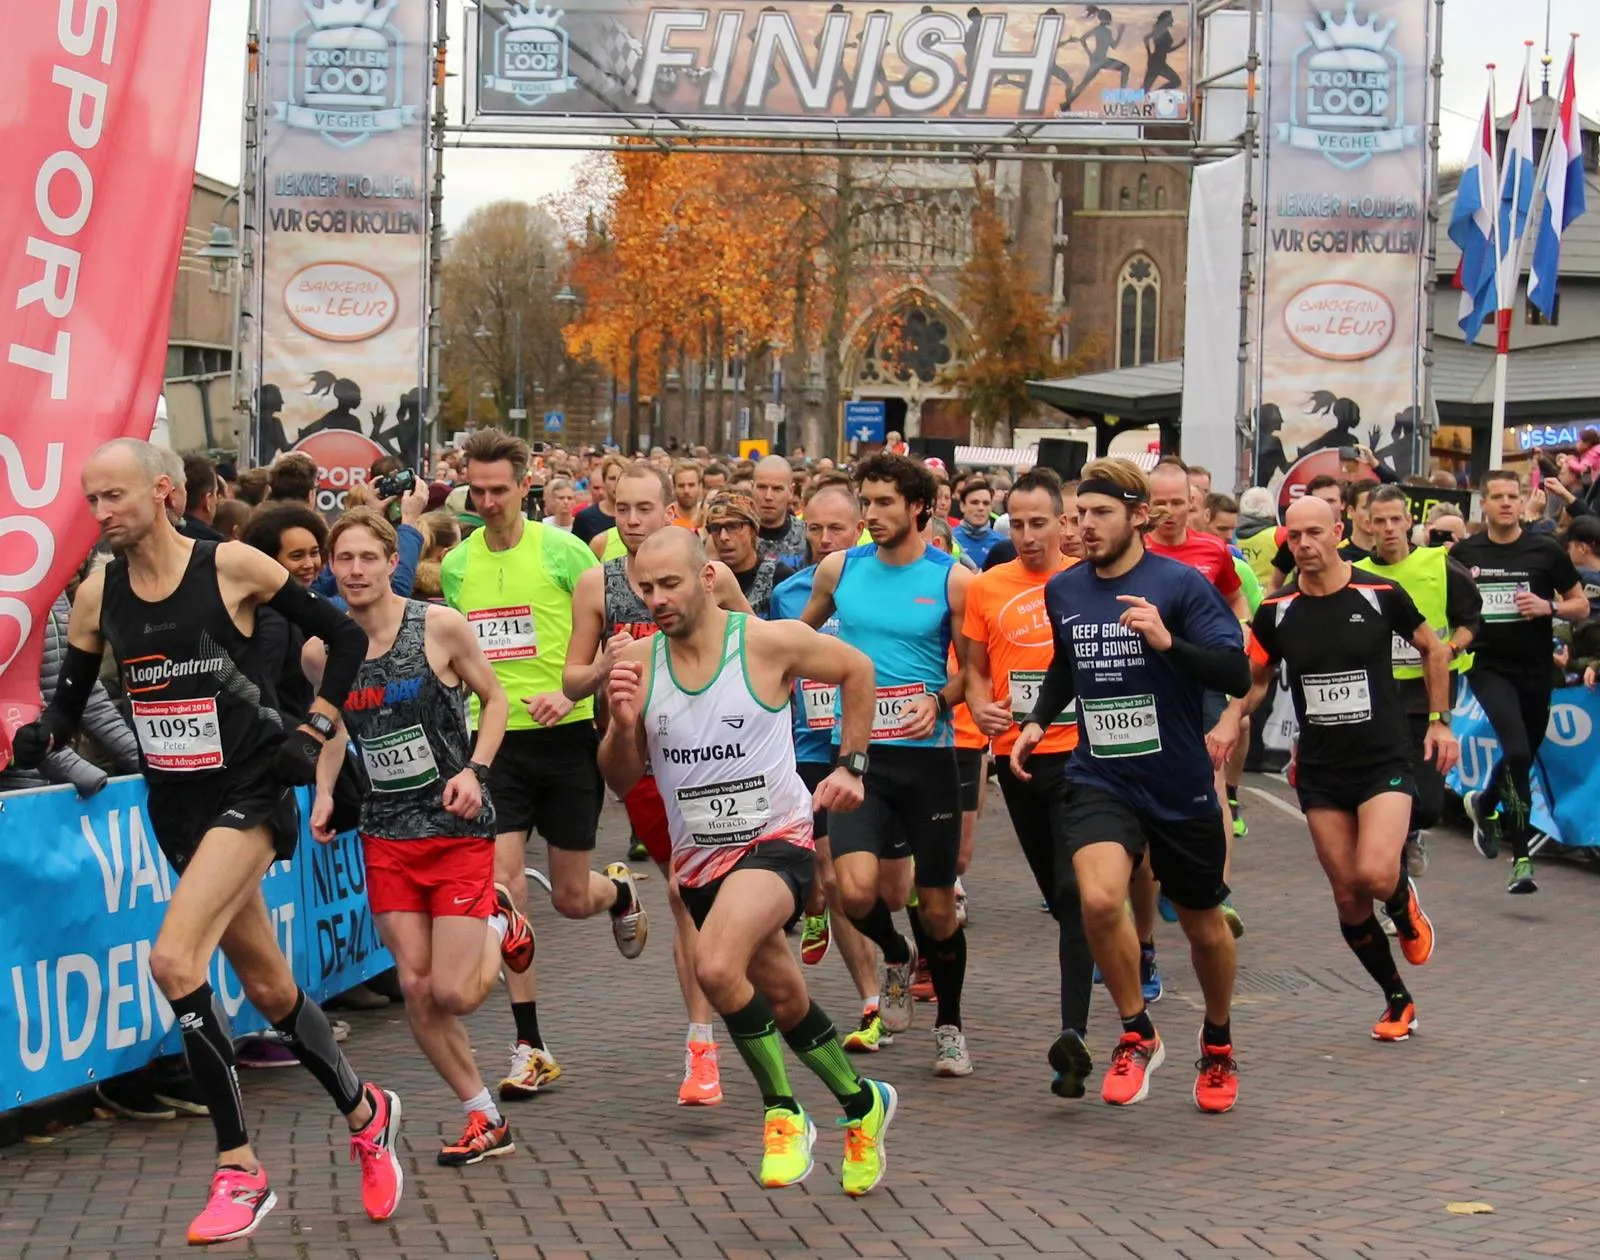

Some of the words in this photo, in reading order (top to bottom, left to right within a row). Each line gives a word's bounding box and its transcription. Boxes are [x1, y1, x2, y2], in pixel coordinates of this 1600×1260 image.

[306, 50, 389, 67] KROLLEN
[505, 54, 561, 71] LOOP
[634, 9, 1066, 113] FINISH
[304, 67, 388, 94] LOOP
[1308, 72, 1390, 89] KROLLEN
[1104, 104, 1153, 117] WEAR
[1306, 88, 1389, 115] LOOP
[314, 113, 383, 128] VEGHEL
[1317, 134, 1381, 149] VEGHEL
[275, 172, 339, 198] LEKKER
[347, 174, 416, 199] HOLLEN
[9, 0, 118, 400] SPORT
[1277, 193, 1342, 219] LEKKER
[1347, 195, 1417, 221] HOLLEN
[270, 207, 303, 233] VUR
[350, 210, 420, 235] KROLLEN
[1271, 228, 1305, 252] VUR
[1352, 230, 1419, 255] KROLLEN
[325, 297, 389, 318] LEUR
[1325, 317, 1387, 336] LEUR
[316, 466, 371, 487] POR
[476, 619, 522, 638] 1241
[1072, 624, 1099, 640] KEEP
[1074, 642, 1099, 658] KEEP
[1102, 640, 1142, 657] GOING!
[131, 657, 223, 685] LoopCentrum
[1095, 660, 1112, 669] WHAT
[1113, 659, 1126, 668] SHE
[1318, 686, 1350, 702] 169
[192, 703, 212, 711] 2016
[146, 718, 201, 738] 1095
[1094, 711, 1143, 731] 3086
[1553, 710, 1577, 740] U
[163, 741, 187, 751] Peter
[662, 743, 746, 765] PORTUGAL
[367, 745, 417, 768] 3021
[1458, 735, 1498, 793] UT
[720, 782, 744, 794] Veghel
[744, 779, 764, 789] 2016
[709, 797, 739, 818] 92
[708, 818, 747, 830] Horacio
[313, 836, 366, 908] NIEU
